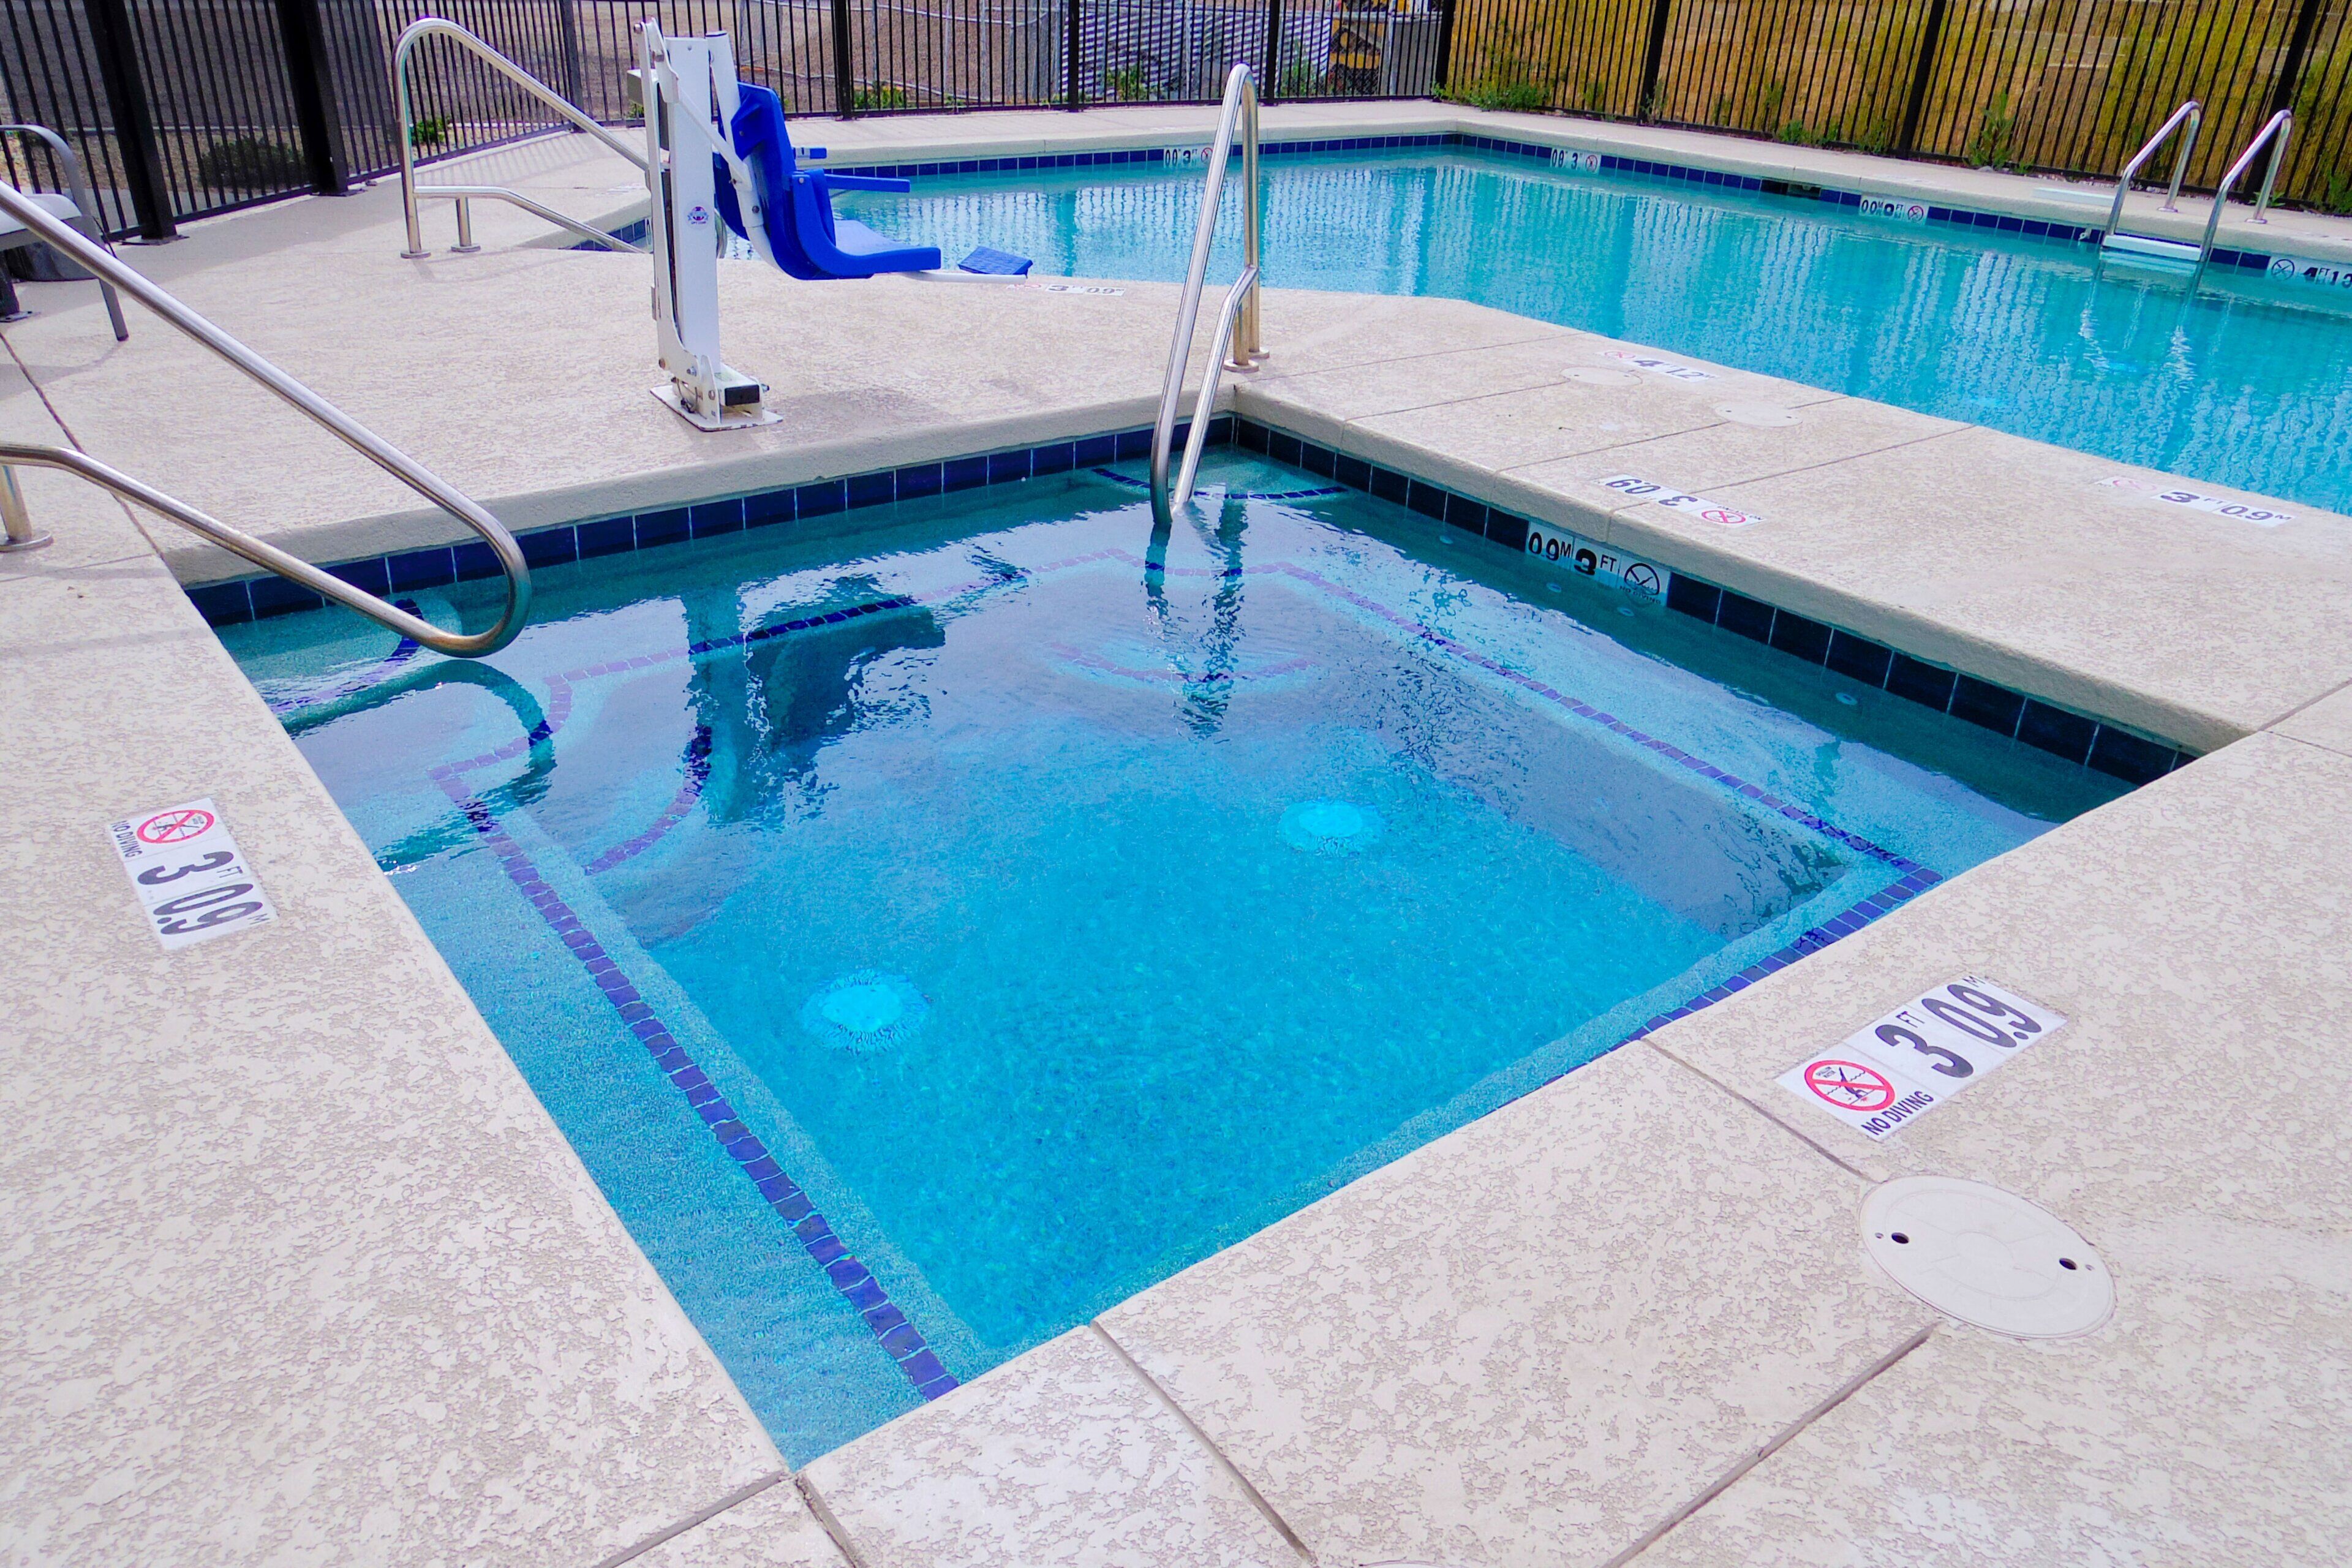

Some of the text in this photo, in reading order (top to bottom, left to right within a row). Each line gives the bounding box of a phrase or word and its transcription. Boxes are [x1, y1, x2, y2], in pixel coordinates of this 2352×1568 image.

[2160, 492, 2199, 503] 3
[2221, 506, 2274, 521] 0.9
[1574, 548, 1597, 576] 3
[1600, 554, 1616, 572] FT
[110, 820, 143, 858] NO DIVING
[137, 851, 234, 885] 3
[1896, 1010, 1926, 1028] FT
[1875, 1024, 1974, 1078] 3
[1860, 1090, 1934, 1136] NO DIVING
